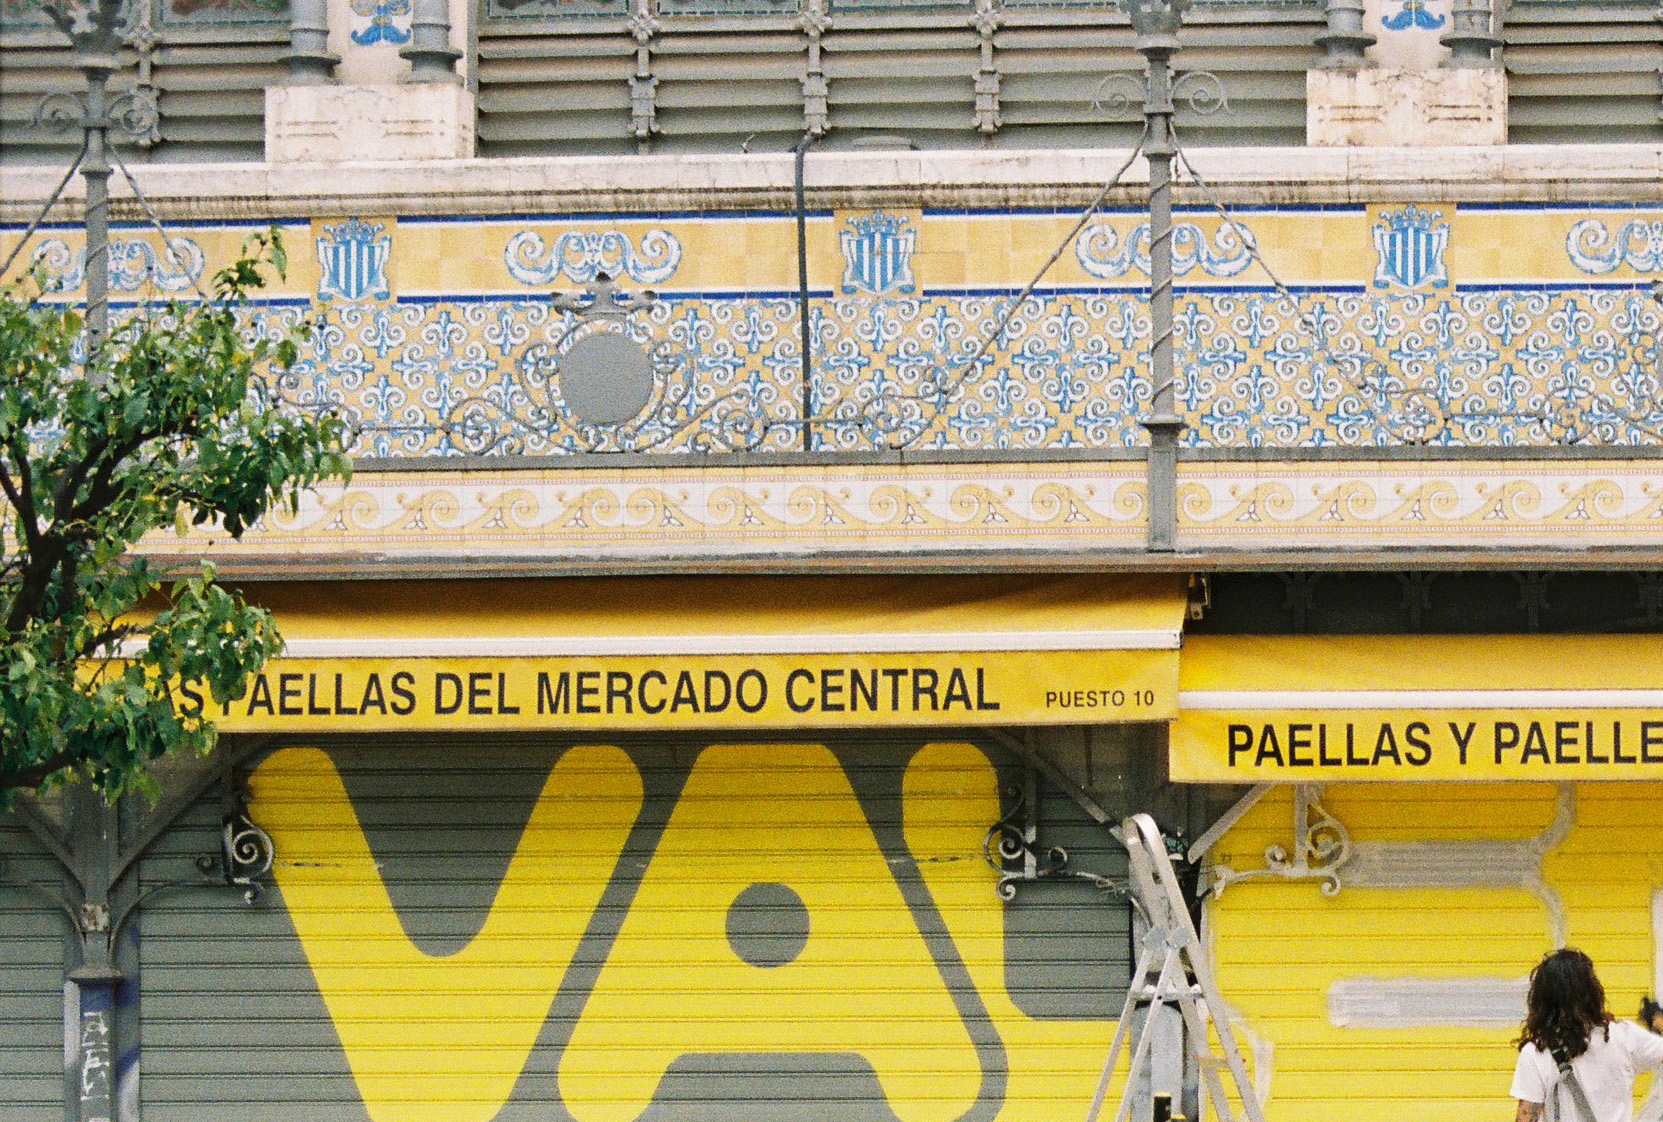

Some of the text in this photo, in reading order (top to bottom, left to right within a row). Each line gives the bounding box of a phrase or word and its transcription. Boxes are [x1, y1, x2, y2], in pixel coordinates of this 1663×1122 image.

[434, 672, 521, 715] DEL
[537, 668, 768, 715] MERCADO
[785, 667, 1000, 713] CENTRAL
[1045, 690, 1155, 708] PUESTO 10
[1228, 721, 1432, 767] PAELLAS
[1448, 722, 1476, 765] Y
